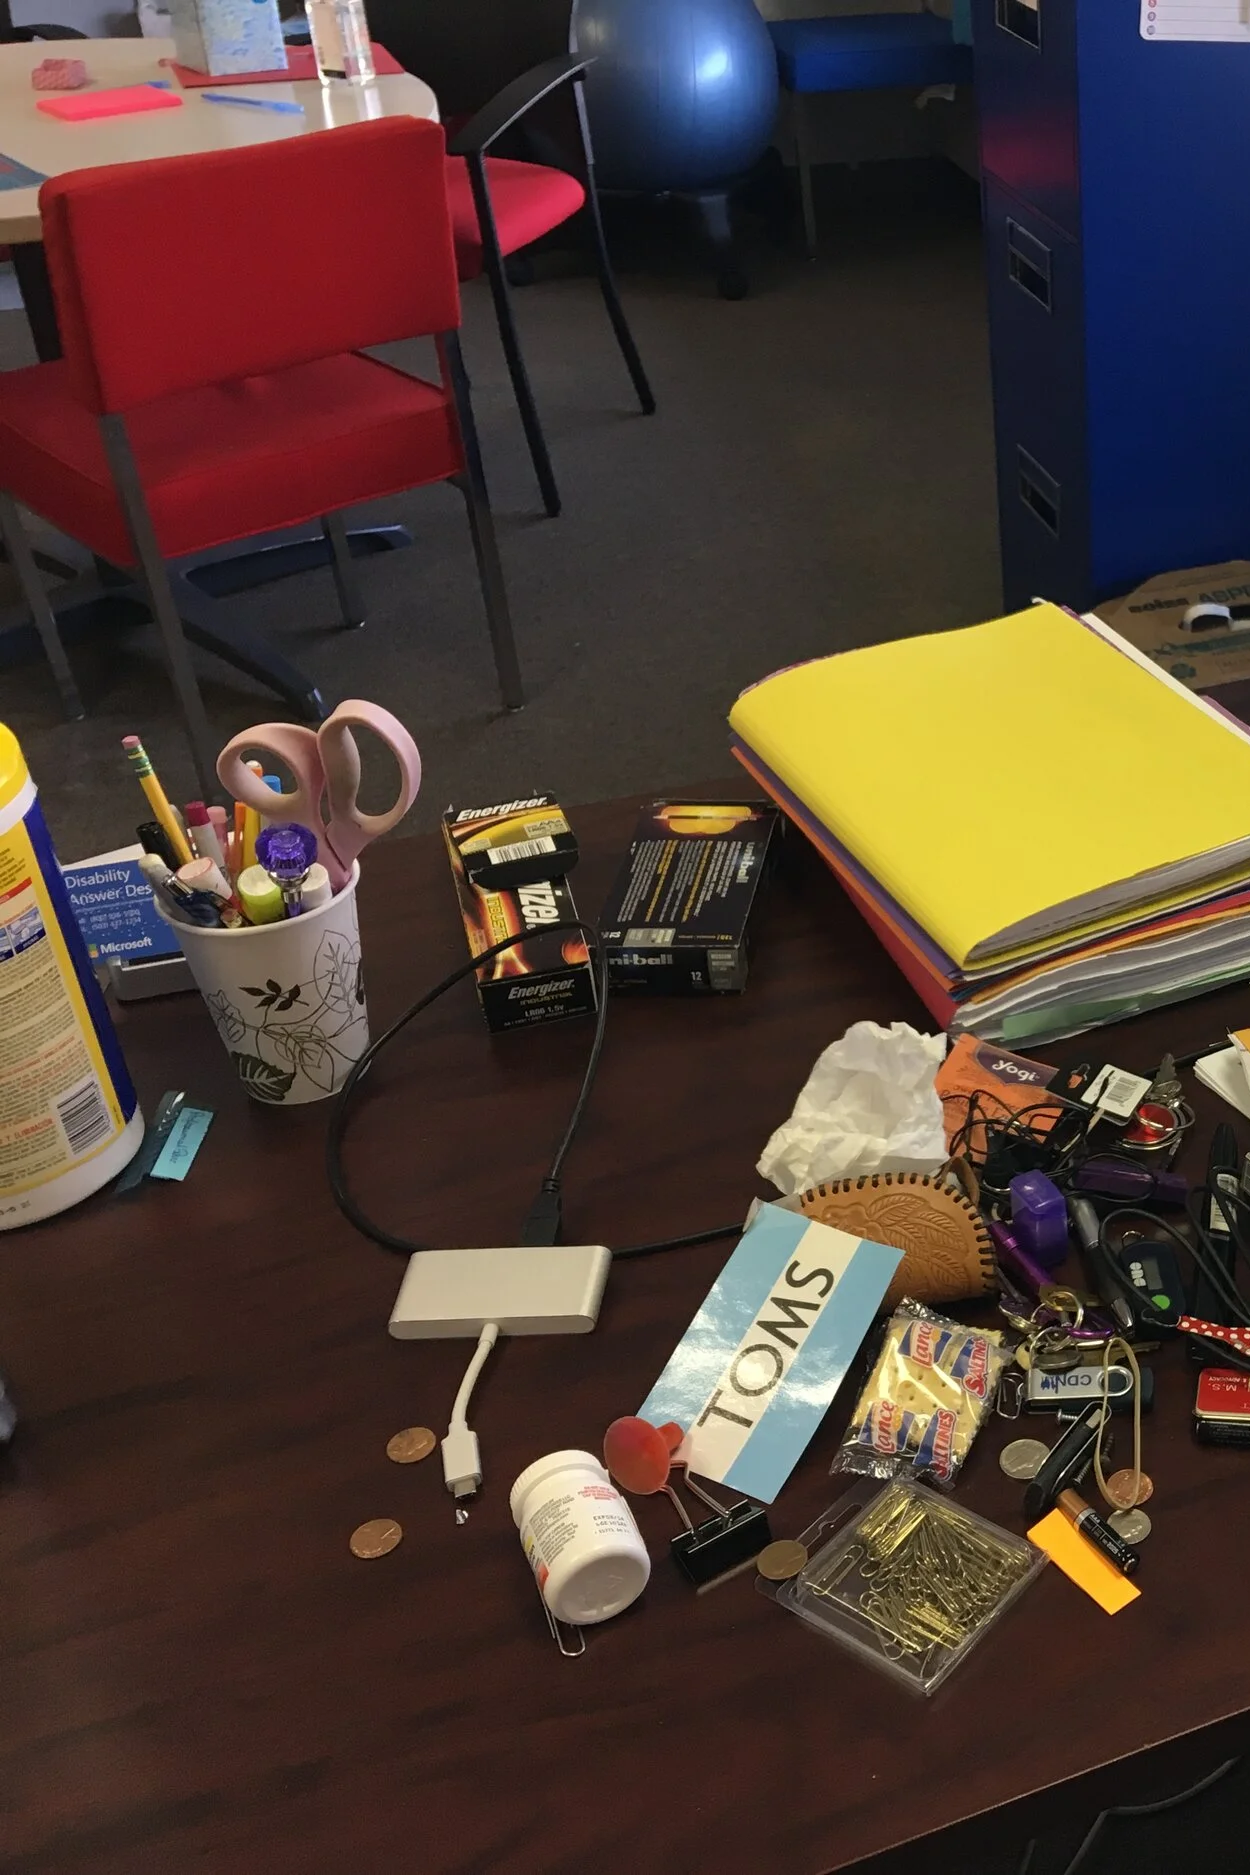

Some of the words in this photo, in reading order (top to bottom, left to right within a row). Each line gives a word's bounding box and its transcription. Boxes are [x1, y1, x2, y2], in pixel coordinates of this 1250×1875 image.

[455, 796, 548, 823] Energizer
[64, 868, 131, 890] Disability
[69, 886, 121, 906] Answer
[125, 883, 153, 898] Des
[100, 936, 153, 955] Microsoft
[690, 970, 703, 982] 12
[507, 977, 575, 1000] Energizer
[991, 1059, 1037, 1082] yogi
[696, 1259, 835, 1430] TOMS
[910, 1321, 934, 1369] Lance
[874, 1400, 898, 1454] Lance
[930, 1408, 957, 1480] SALTINES
